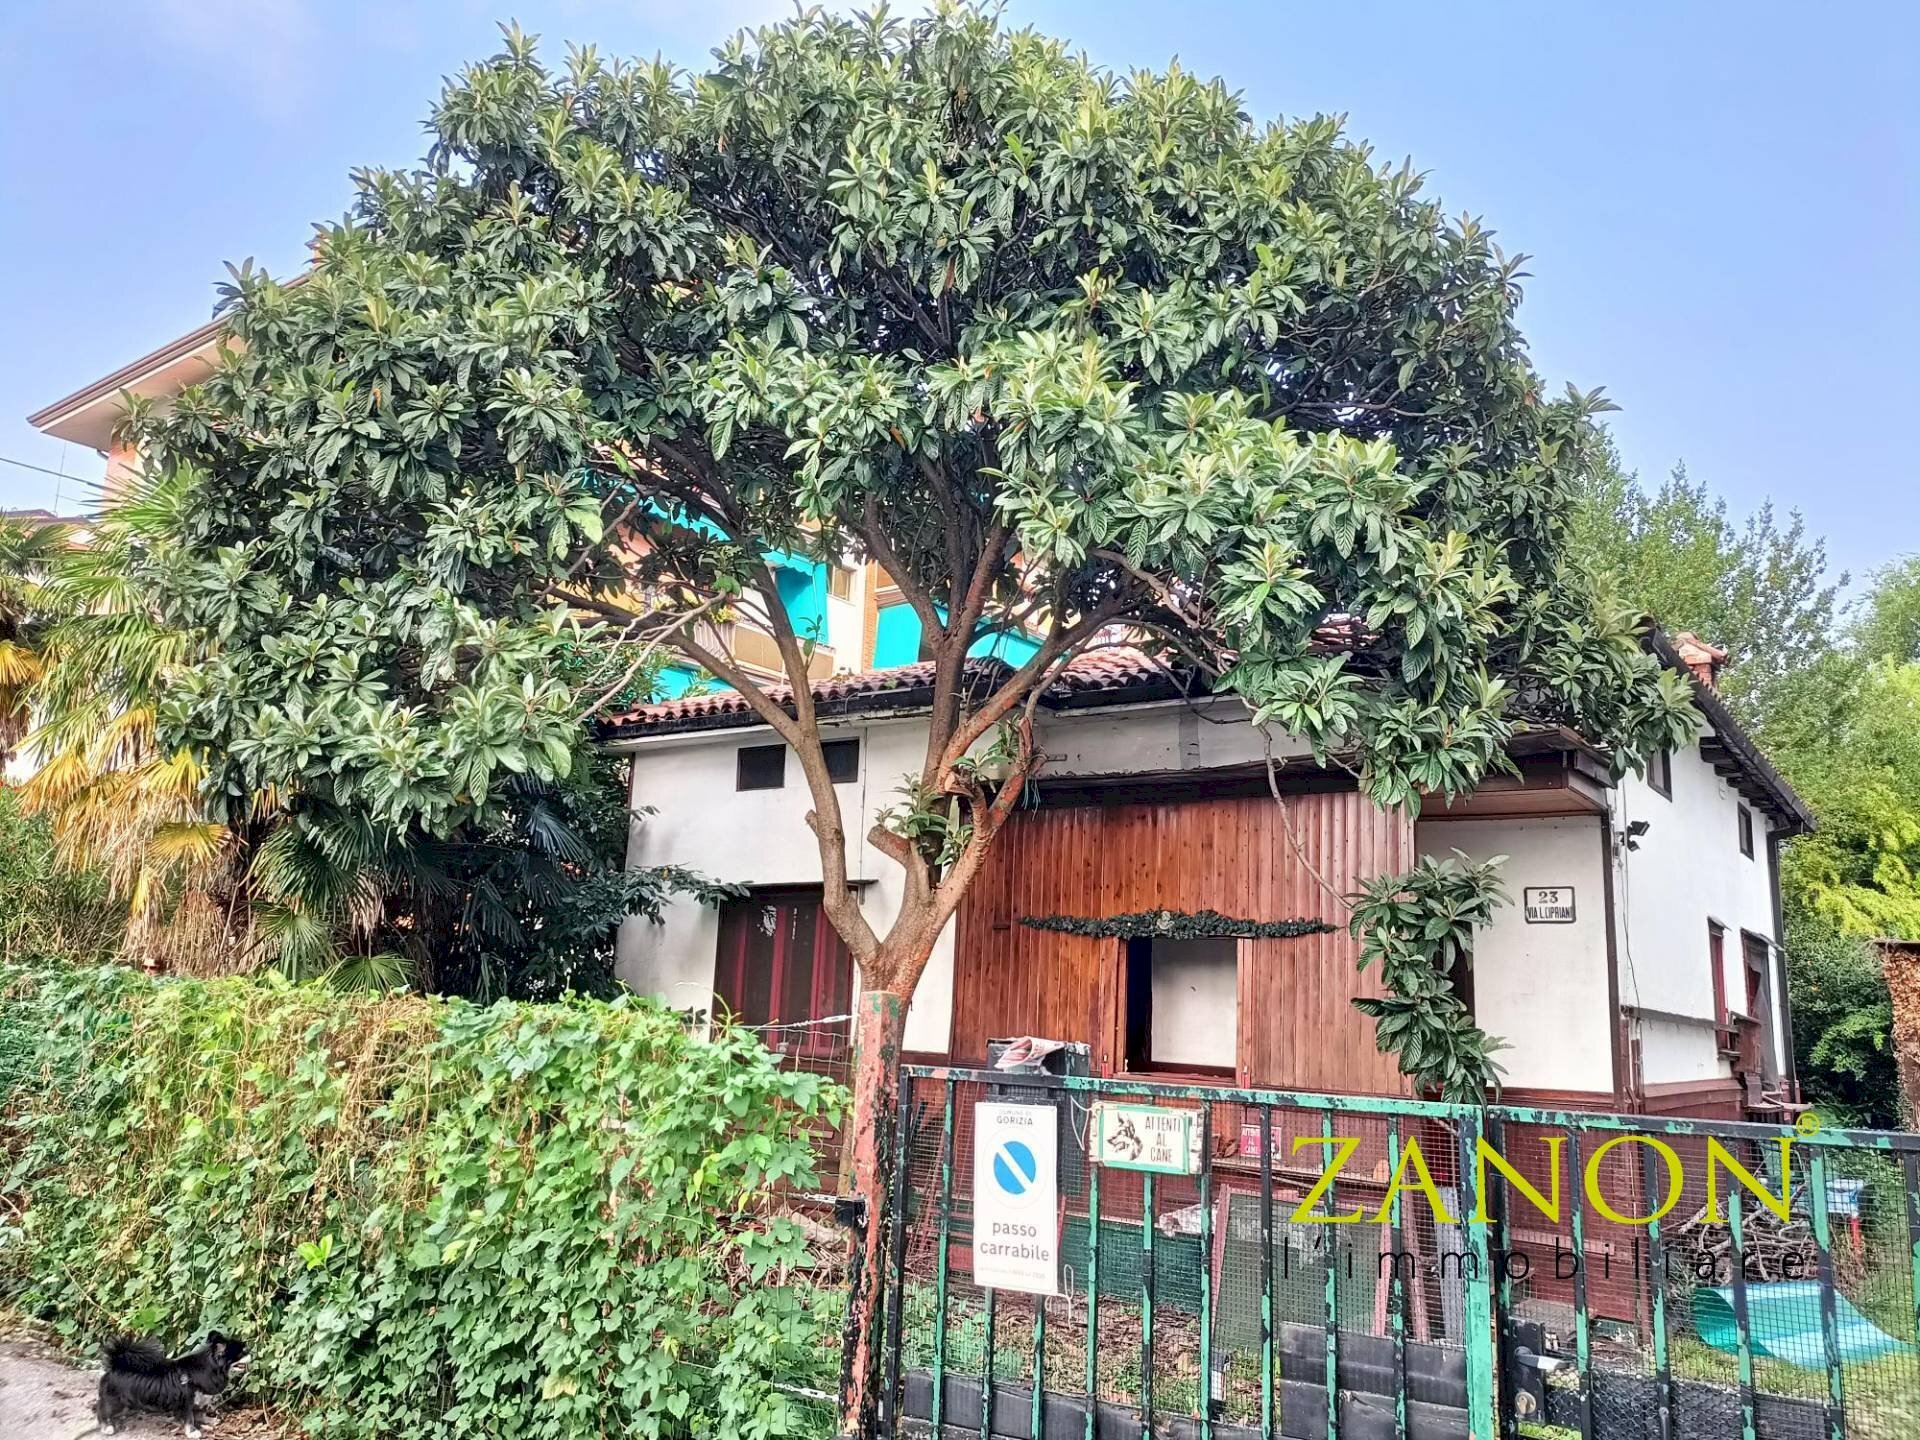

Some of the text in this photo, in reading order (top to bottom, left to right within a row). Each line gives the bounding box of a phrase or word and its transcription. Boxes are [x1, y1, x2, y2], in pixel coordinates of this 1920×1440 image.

[1538, 891, 1559, 904] 23
[1526, 906, 1538, 919] VIA
[996, 1115, 1033, 1126] GORIZIA
[1145, 1116, 1181, 1133] ATTENTI
[1156, 1132, 1167, 1147] AL
[1150, 1147, 1172, 1163] CANE
[992, 1220, 1037, 1239] passo
[980, 1240, 1050, 1261] carrabile
